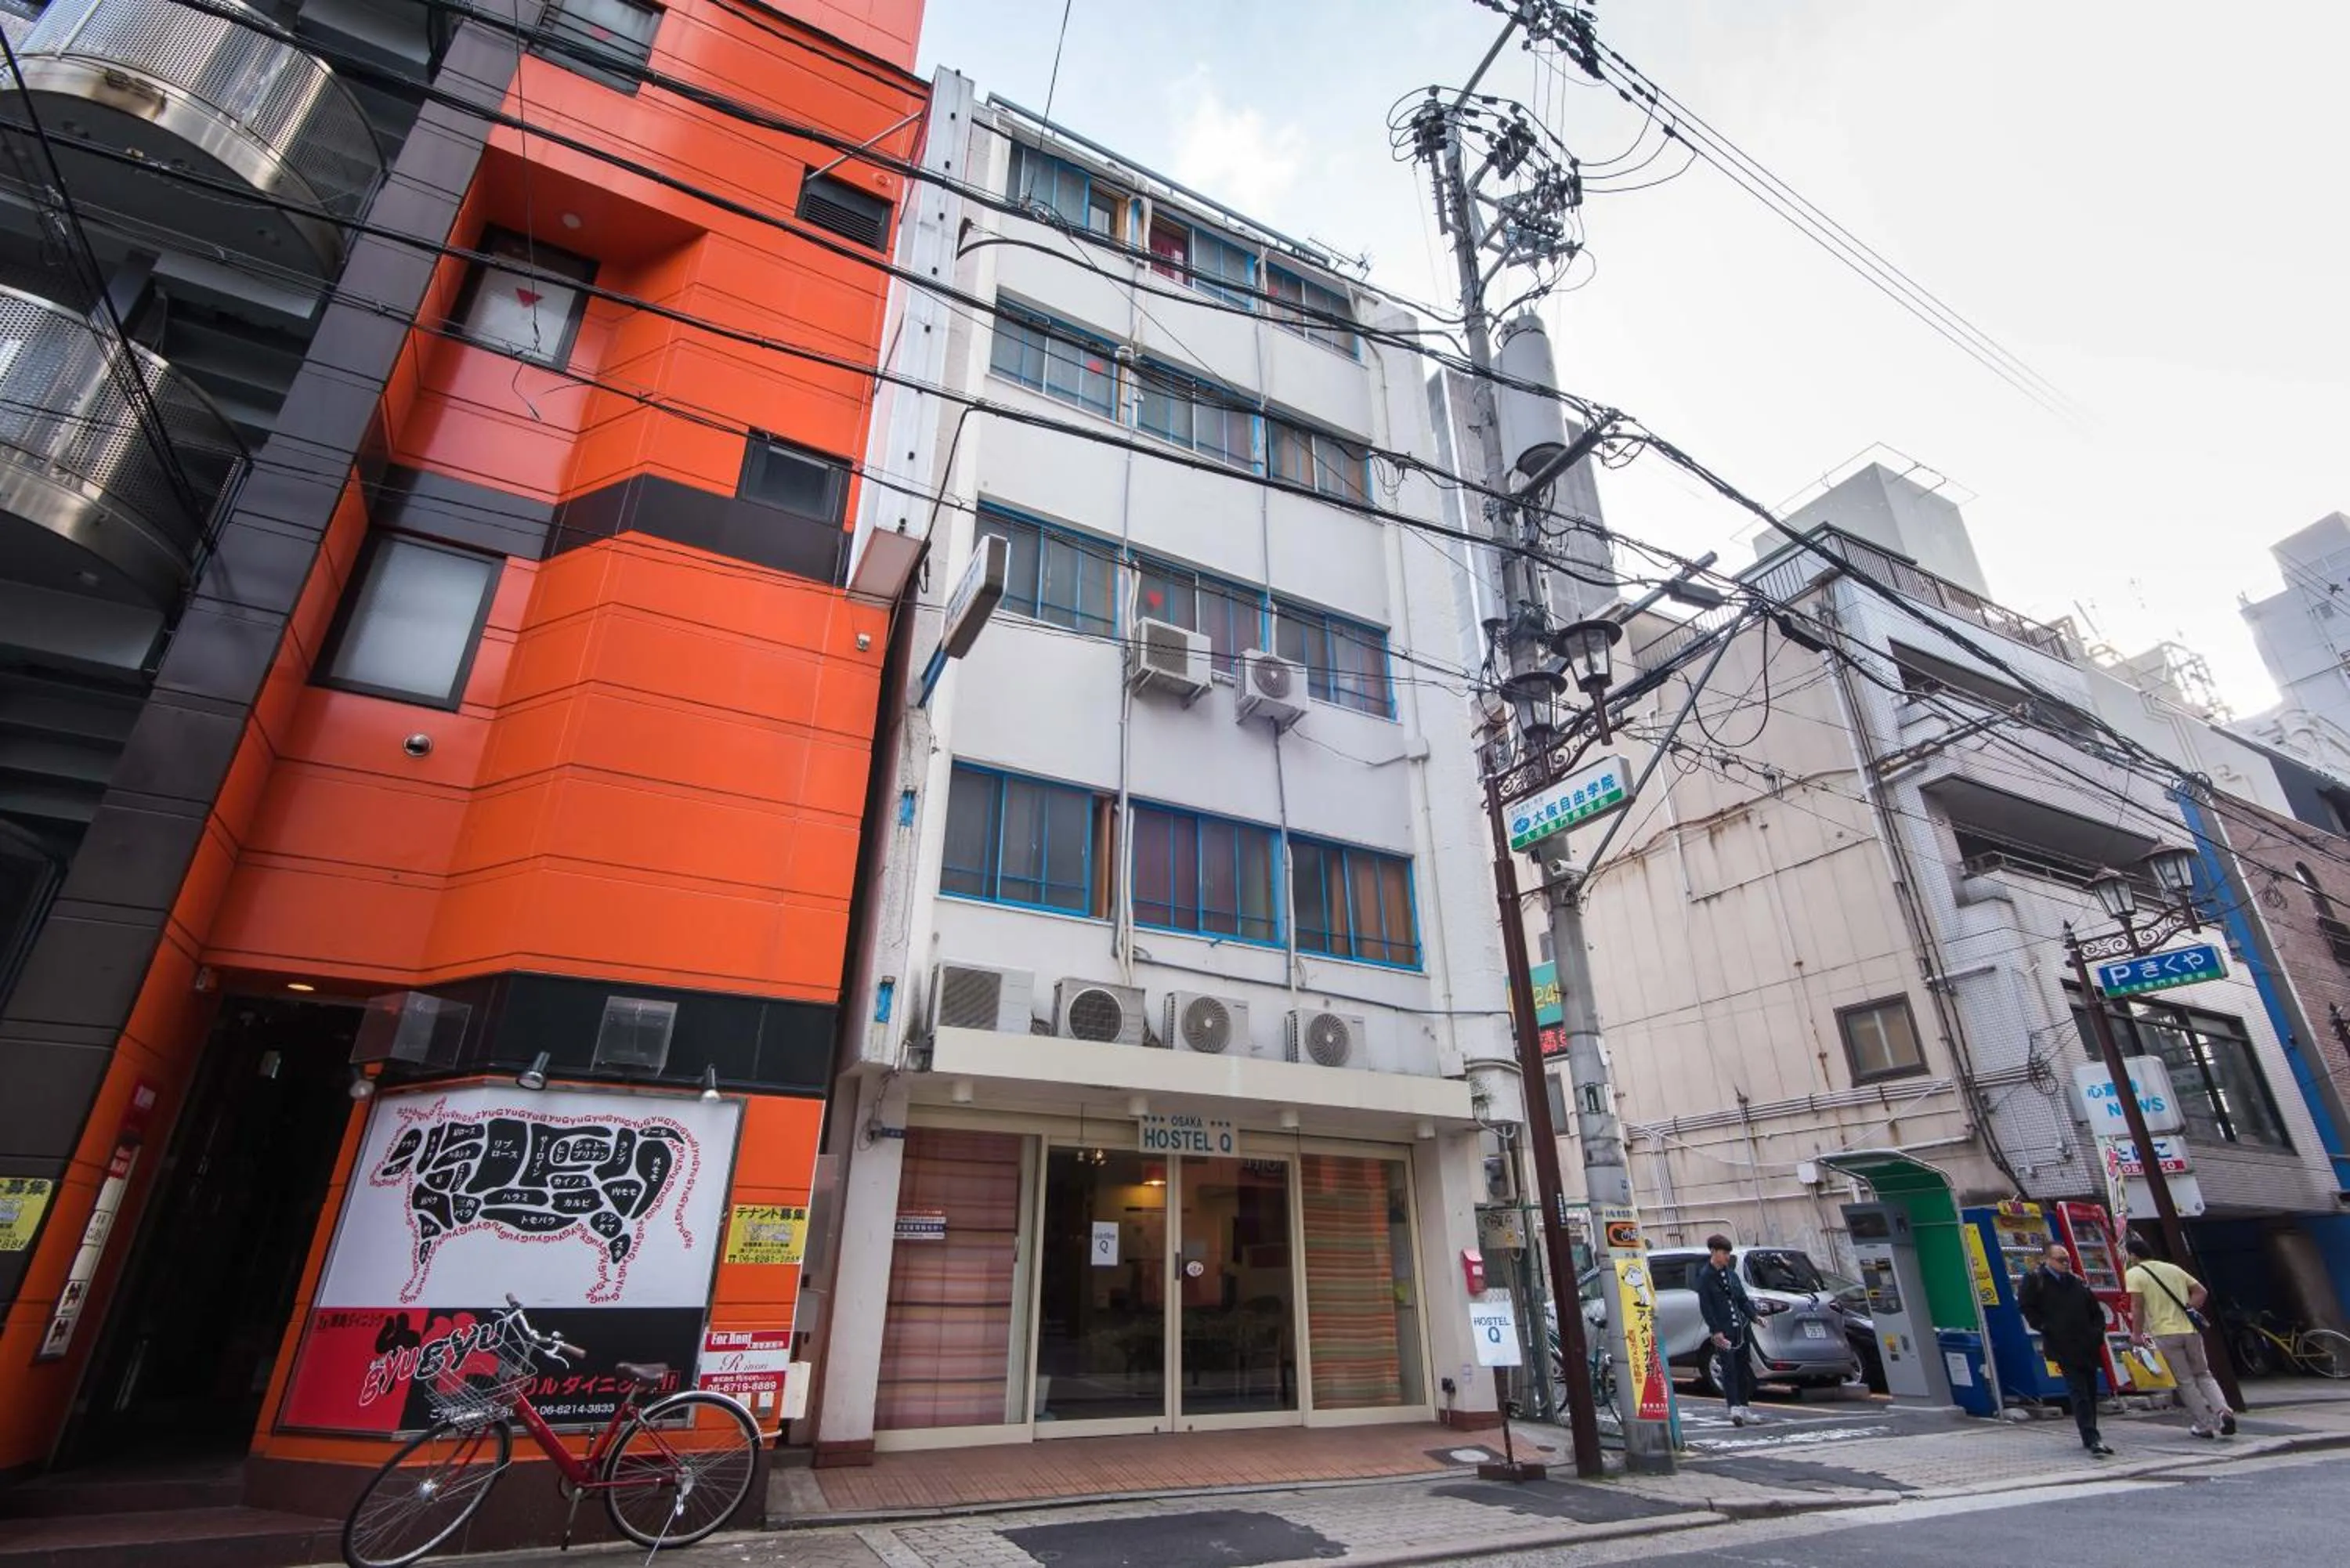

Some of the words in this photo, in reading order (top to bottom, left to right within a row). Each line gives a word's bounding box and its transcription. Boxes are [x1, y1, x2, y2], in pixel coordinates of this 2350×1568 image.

[1533, 774, 1615, 825] 大阪自由学院
[2108, 965, 2131, 986] P
[2139, 952, 2204, 978] きくや
[2106, 1097, 2166, 1117] NWS
[1171, 1115, 1202, 1127] OSAKA
[1144, 1128, 1213, 1151] HOSTEL
[1219, 1133, 1232, 1154] Q
[553, 1177, 588, 1187] カイノミ
[501, 1192, 530, 1202] ハラミ
[563, 1198, 591, 1208] カルビ
[520, 1215, 557, 1226] トモバラ
[1099, 1239, 1109, 1255] Q
[1473, 1316, 1511, 1327] HOSTEL
[1488, 1326, 1501, 1344] Q
